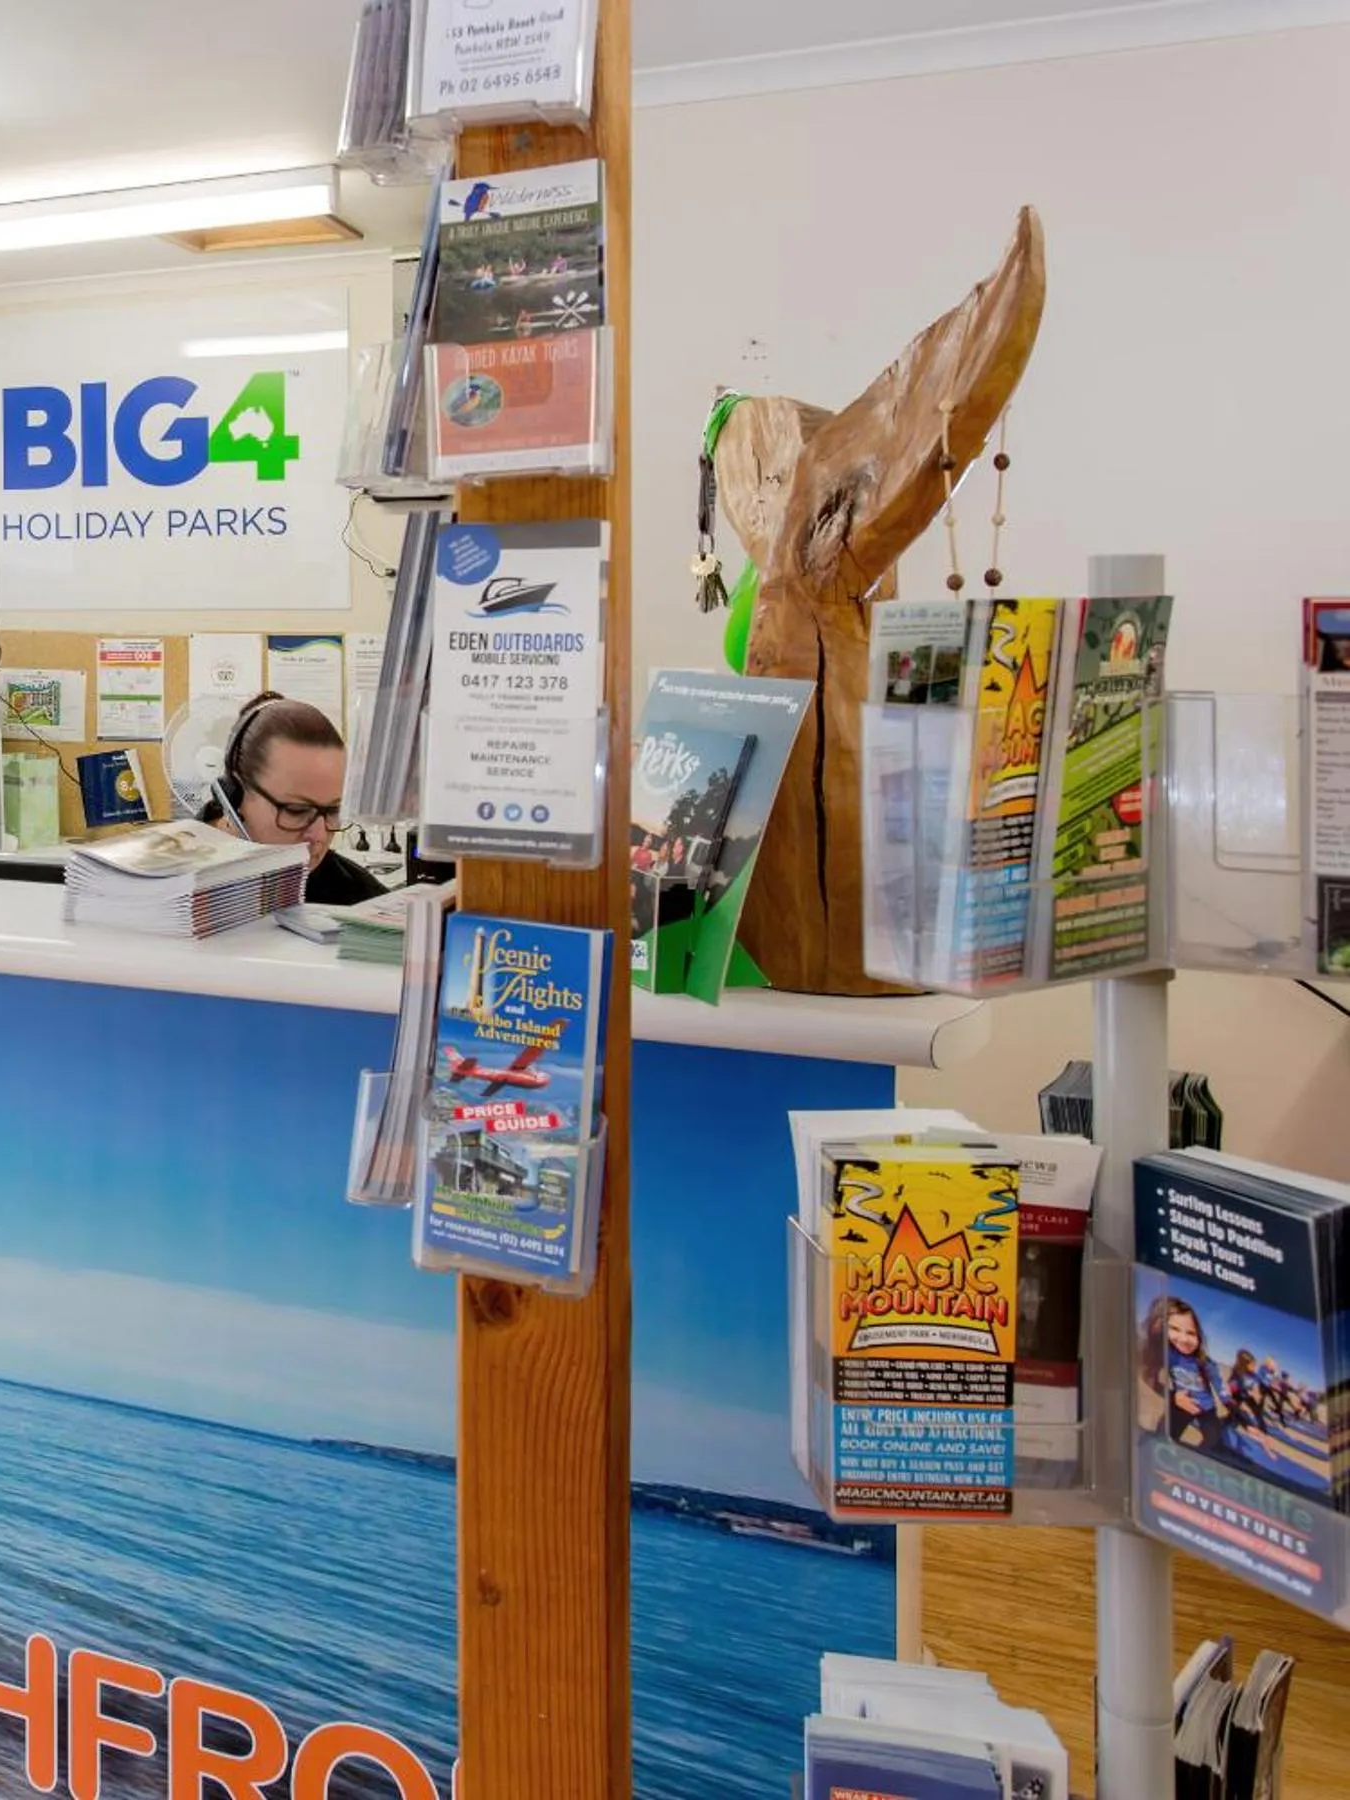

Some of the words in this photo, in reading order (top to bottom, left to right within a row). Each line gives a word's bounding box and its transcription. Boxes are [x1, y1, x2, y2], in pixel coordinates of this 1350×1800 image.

[439, 79, 455, 97] Ph
[459, 77, 478, 93] 02
[501, 344, 538, 366] KAYAK
[2, 370, 299, 490] BIG4
[3, 510, 153, 541] HOLIDAY
[168, 506, 288, 537] PARKS
[449, 631, 489, 650] EDEN
[493, 632, 585, 653] OUTBOARDS
[471, 652, 507, 665] MOBILE
[510, 653, 561, 666] SERVICING
[461, 674, 500, 688] 0417
[506, 675, 534, 689] 123
[539, 676, 569, 690] 378
[486, 739, 537, 751] REPAIRS
[470, 753, 552, 765] MAINTENANCE
[486, 766, 535, 778] SERVICE
[463, 928, 552, 973] Scenic
[481, 966, 583, 1011] Flights
[505, 1004, 525, 1015] and
[474, 1026, 560, 1050] Adventures
[516, 1020, 561, 1037] Island
[462, 1102, 518, 1118] PRICE
[493, 1115, 551, 1132] GUIDE
[1168, 1188, 1213, 1218] Surfing
[1215, 1204, 1264, 1235] Lessons
[1169, 1208, 1205, 1233] Stand
[1207, 1220, 1225, 1241] Up
[1227, 1228, 1284, 1264] Paddling
[1170, 1228, 1209, 1253] Kayak
[1210, 1241, 1245, 1267] Tours
[846, 1252, 998, 1295] MAGIC
[1172, 1248, 1212, 1275] School
[1214, 1263, 1256, 1291] Camps
[840, 1289, 1008, 1327] MOUNTAIN
[909, 1329, 930, 1338] PARK
[841, 1407, 873, 1422] ENTRY
[877, 1408, 907, 1424] PRICE
[840, 1439, 880, 1450] BOOK
[882, 1441, 933, 1453] ONLINE
[935, 1443, 966, 1454] AND
[968, 1444, 1006, 1456] SAVE!
[836, 1486, 1006, 1503] MAGICMOUNTAIN.NET.AU
[1171, 1485, 1308, 1554] ADVENTURES
